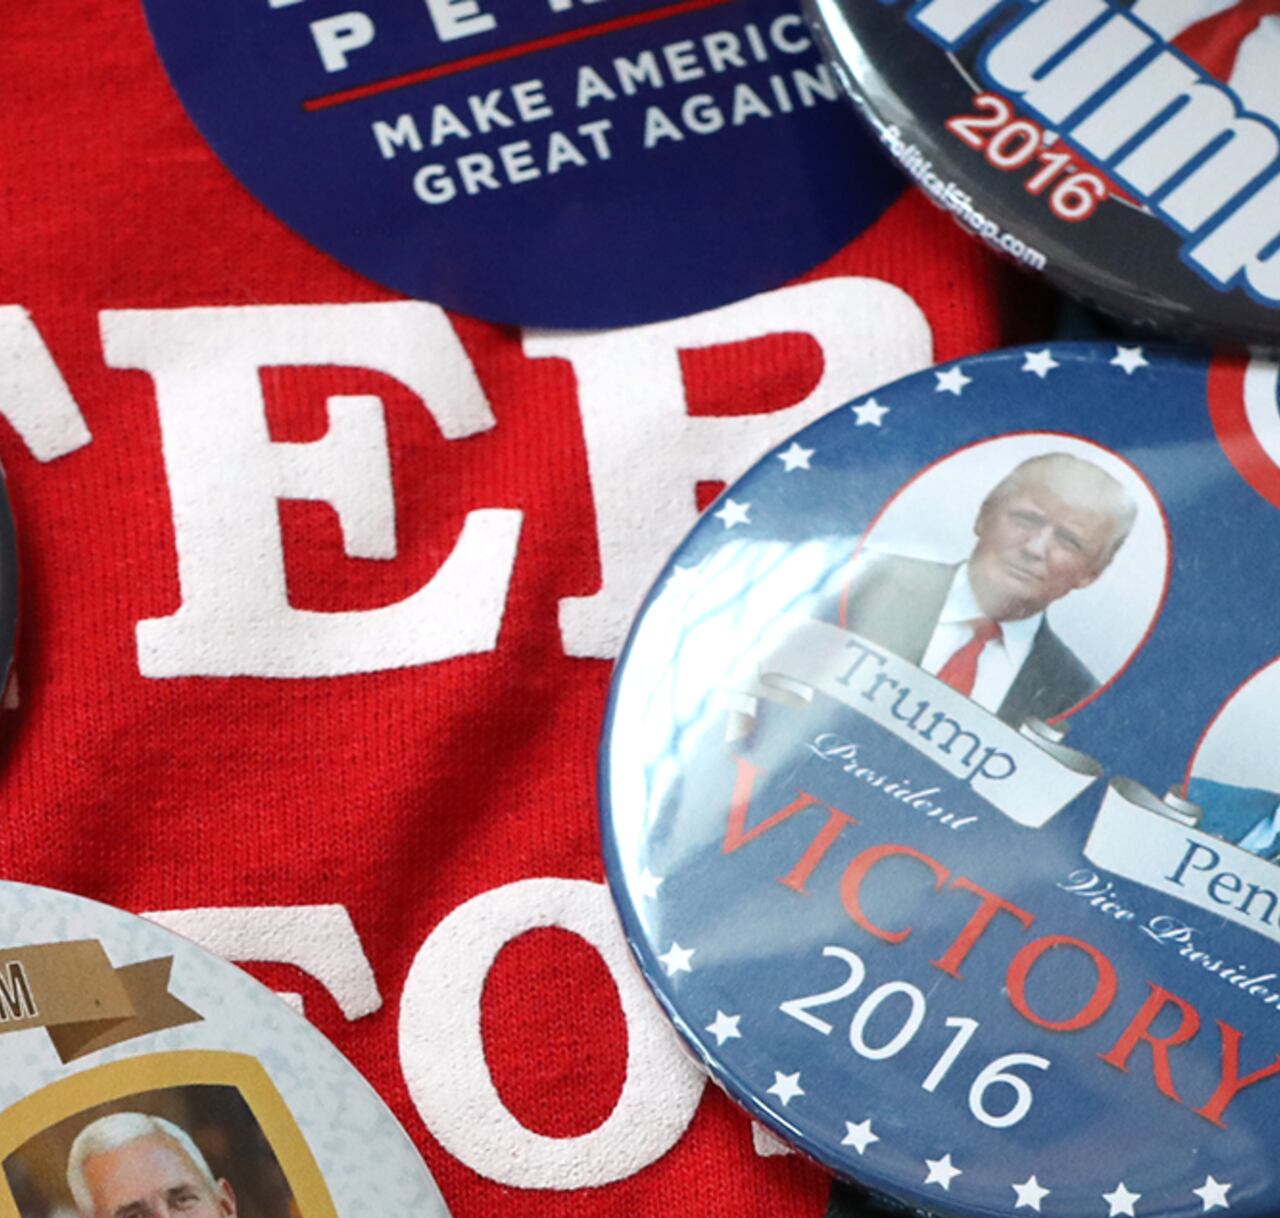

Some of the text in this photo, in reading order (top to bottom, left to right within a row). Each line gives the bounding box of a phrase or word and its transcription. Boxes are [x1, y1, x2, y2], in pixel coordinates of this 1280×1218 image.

[371, 14, 818, 160] MAKE AMERIC
[412, 63, 839, 205] GREAT AGAIN
[945, 92, 1107, 220] 2016
[878, 123, 1048, 271] PoliticalShop.com
[806, 731, 980, 832] President
[834, 637, 1019, 786] Trump
[1055, 867, 1137, 922] Vice
[778, 945, 1053, 1129] 2016
